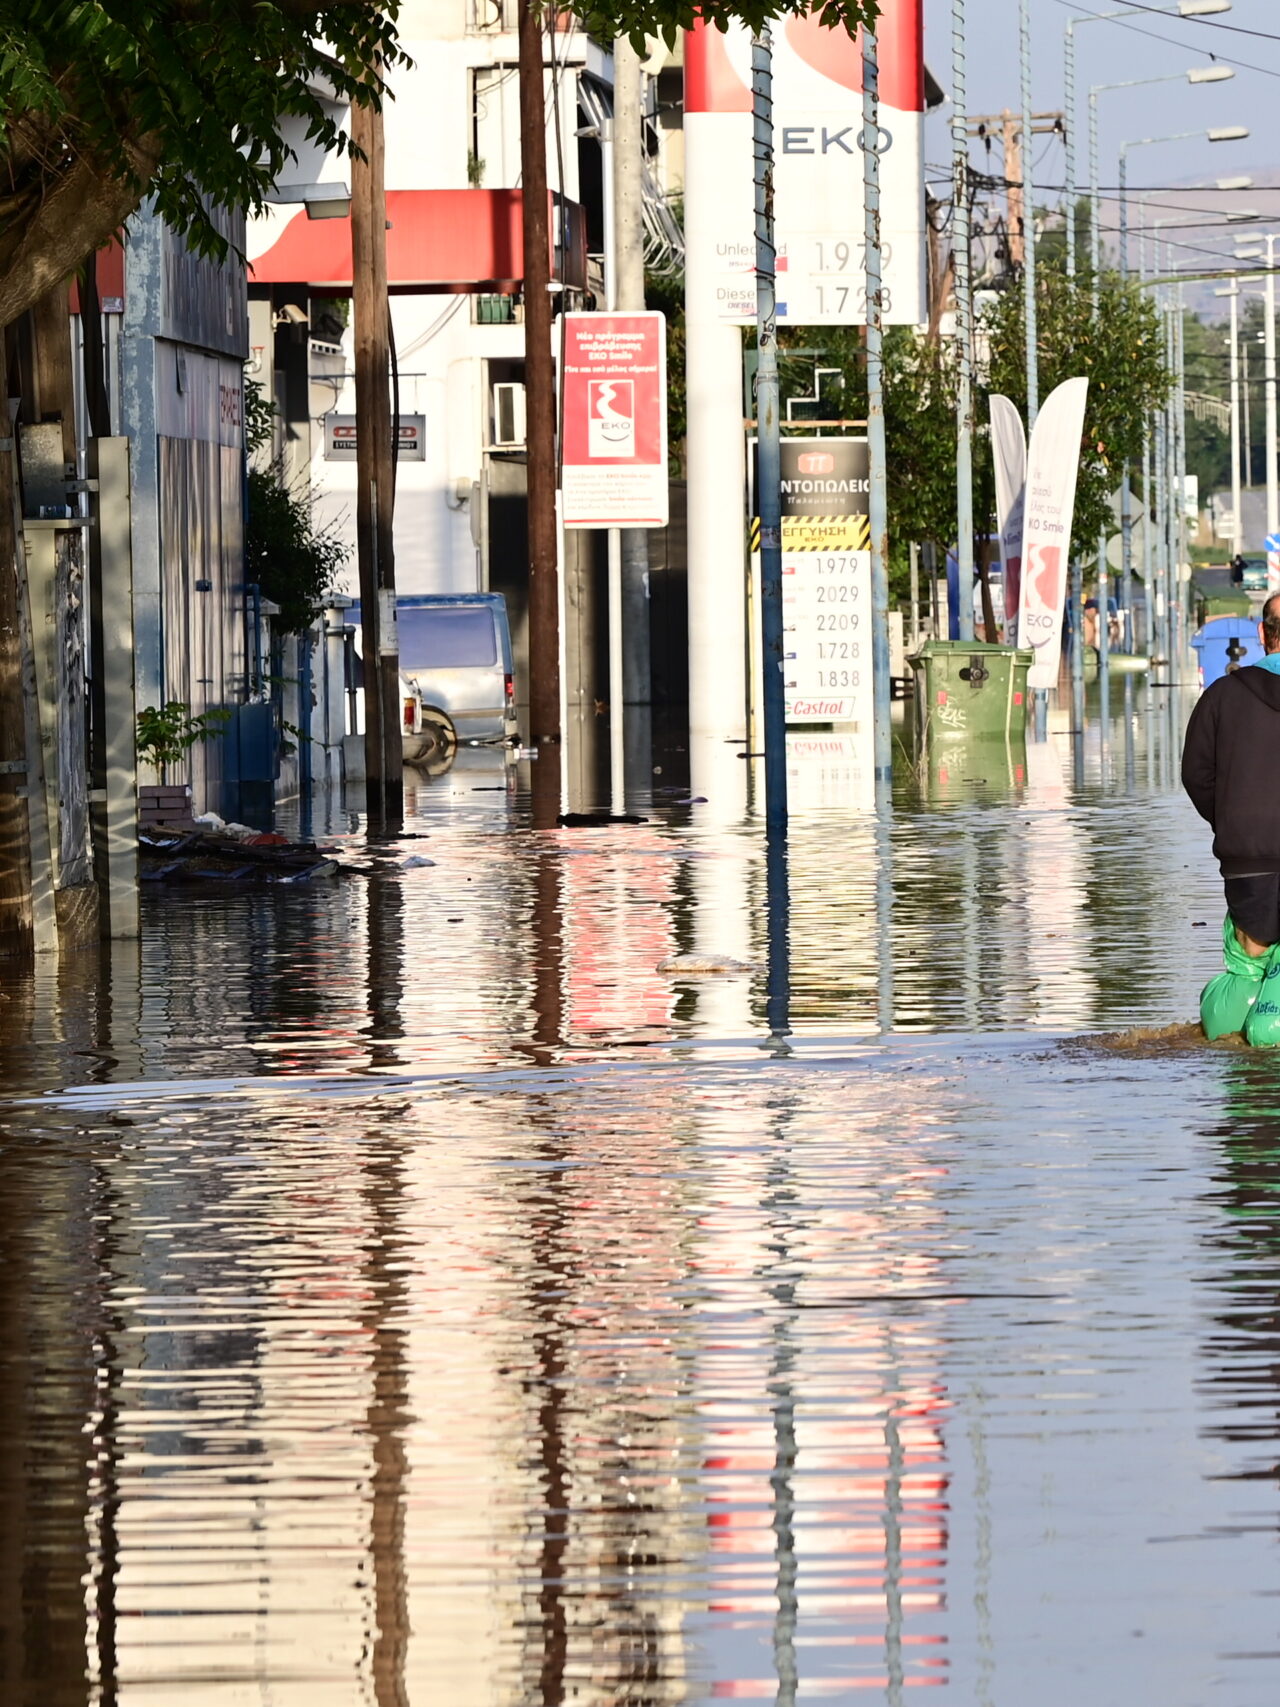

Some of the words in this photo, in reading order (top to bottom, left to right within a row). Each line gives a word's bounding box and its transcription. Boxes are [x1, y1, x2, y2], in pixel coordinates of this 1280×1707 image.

[782, 127, 893, 155] EKO
[716, 287, 755, 300] Diese
[588, 352, 607, 360] EKO
[609, 351, 633, 360] Smile
[601, 422, 631, 430] EKO
[782, 526, 846, 537] ΕΓΓΥΗΣΗ
[1027, 613, 1053, 628] EKO
[794, 700, 843, 715] Castrol
